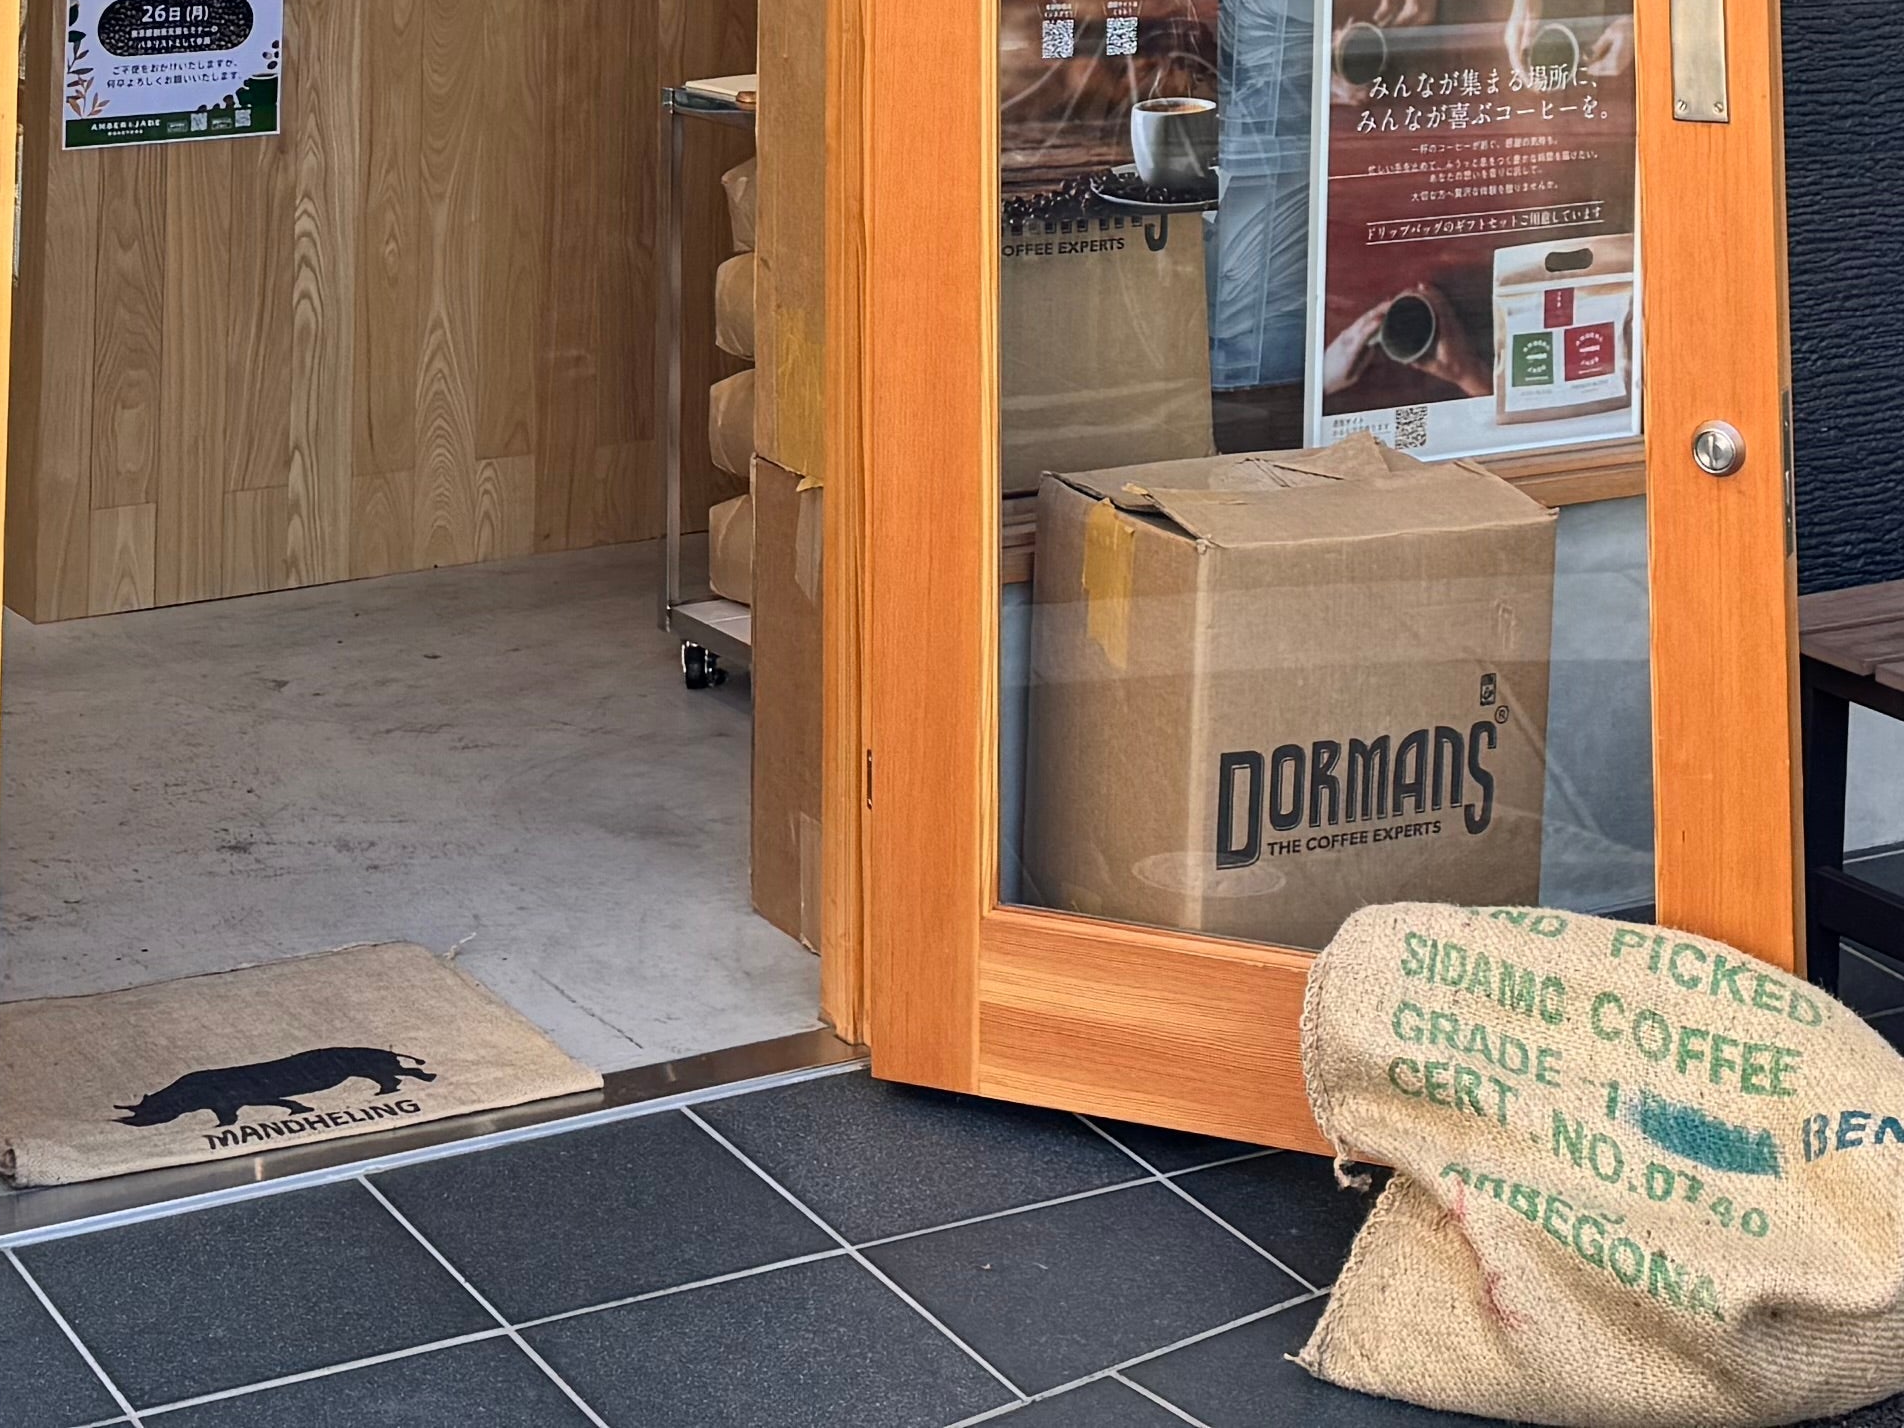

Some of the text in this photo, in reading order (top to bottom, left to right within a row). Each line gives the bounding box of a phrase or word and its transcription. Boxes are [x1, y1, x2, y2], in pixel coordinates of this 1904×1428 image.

[112, 59, 238, 76] ご不便をおかけいたしますが、
[1368, 63, 1598, 101] みんなが集まる場所に、
[1356, 96, 1609, 134] みんなが喜ぶコーヒーを。
[1002, 237, 1126, 257] OFFEE EXPERTS
[1216, 720, 1497, 870] DORMANS
[1267, 821, 1442, 857] THE COFFEE EXPERTS
[1609, 927, 1825, 1028] PICKED
[1400, 931, 1803, 1098] SIDAMO COFFEE
[1391, 1000, 1563, 1088] GRADE
[1388, 1056, 1519, 1127] CERT
[202, 1099, 422, 1150] MANDHELING
